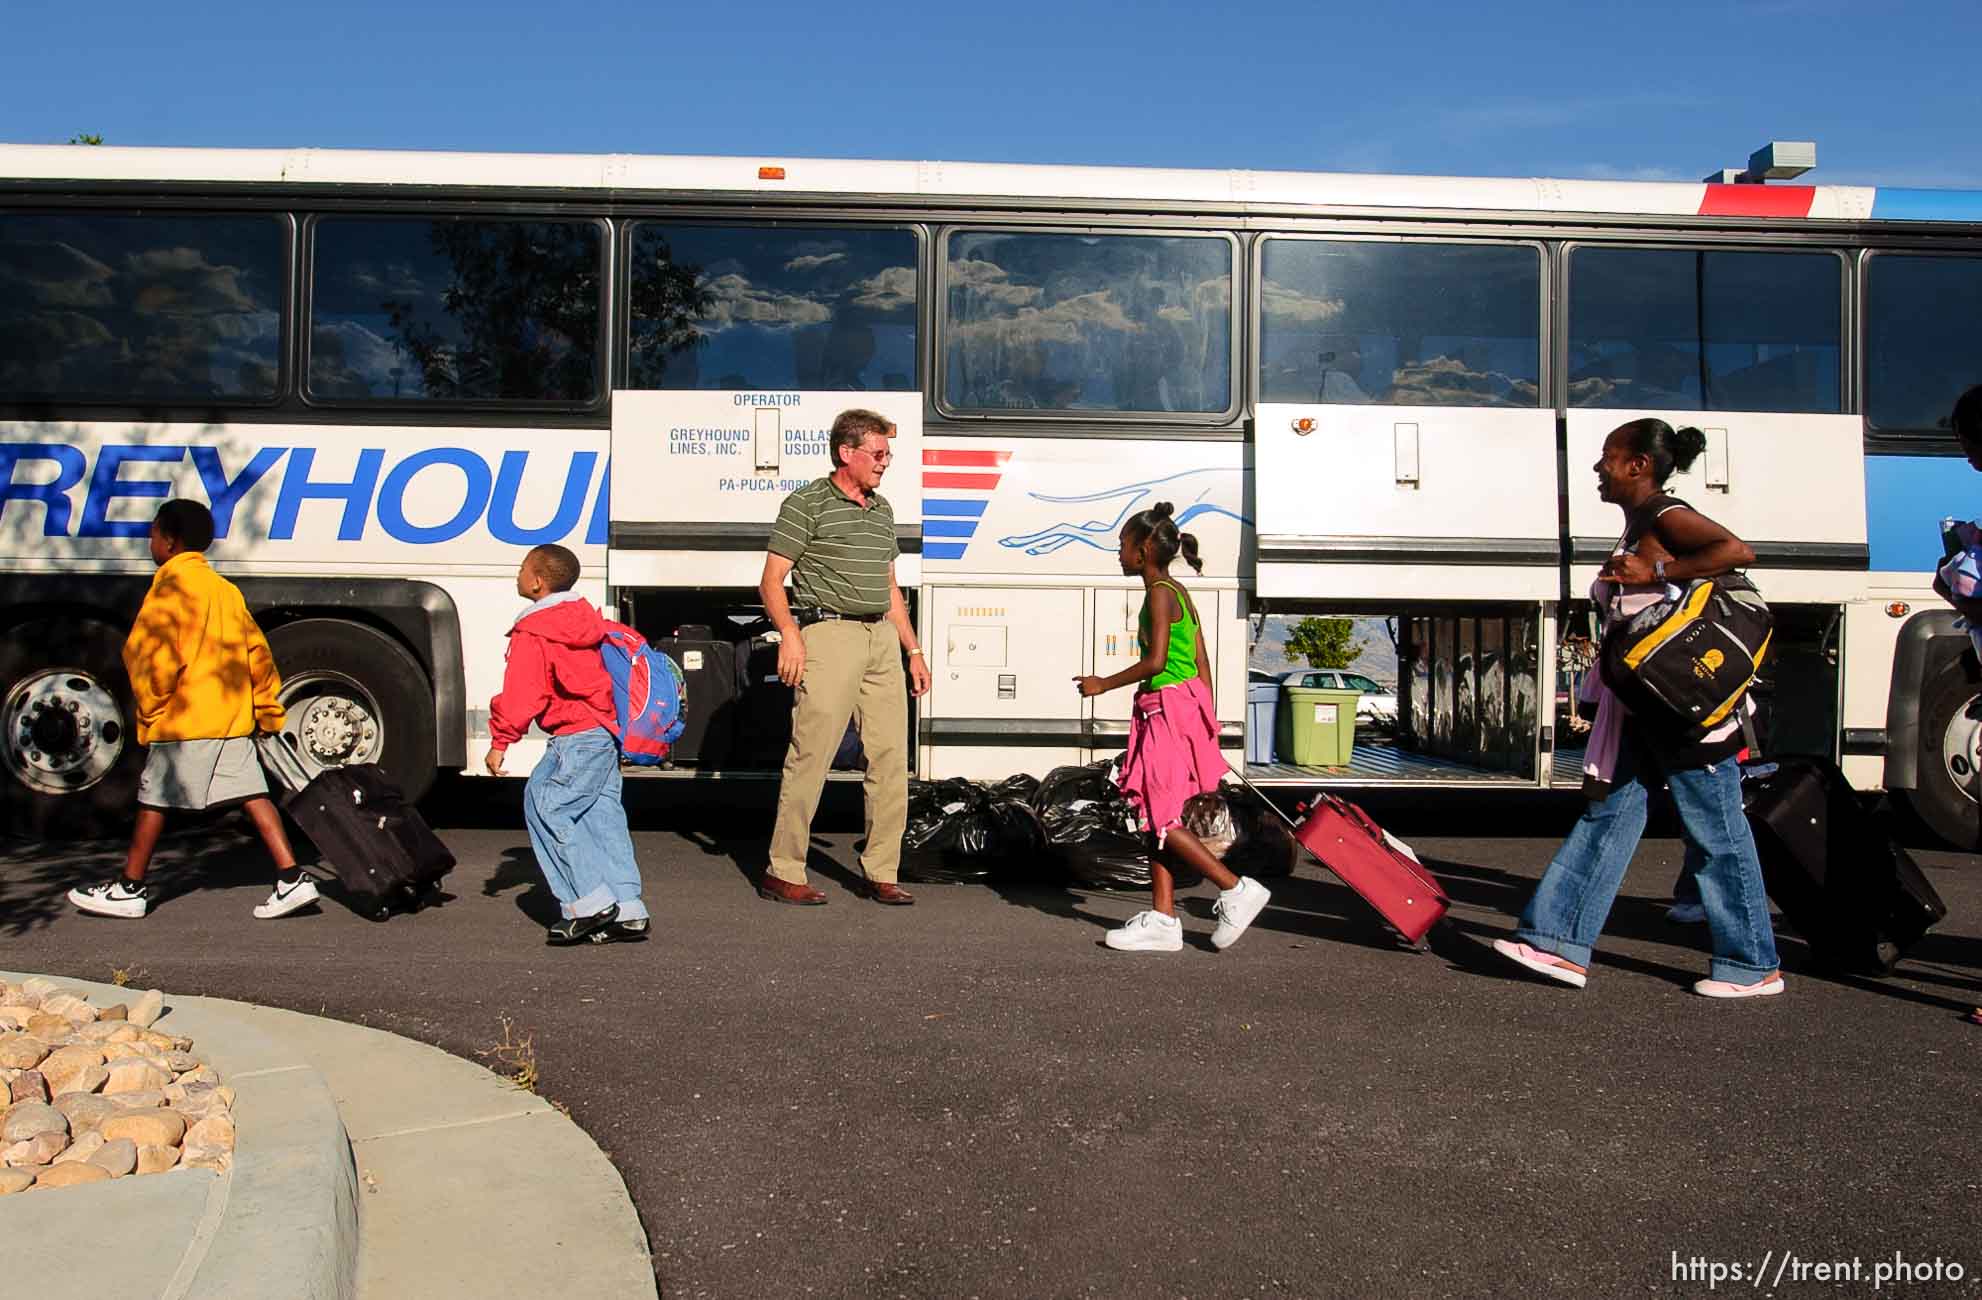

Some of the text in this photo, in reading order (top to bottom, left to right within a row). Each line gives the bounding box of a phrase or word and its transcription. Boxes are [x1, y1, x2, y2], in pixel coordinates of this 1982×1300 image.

[734, 394, 801, 406] OPERATOR
[670, 428, 750, 441] GREYHOUND
[670, 443, 742, 456] LINES, INC.
[785, 443, 827, 455] USDOT
[0, 443, 611, 546] REYHOU
